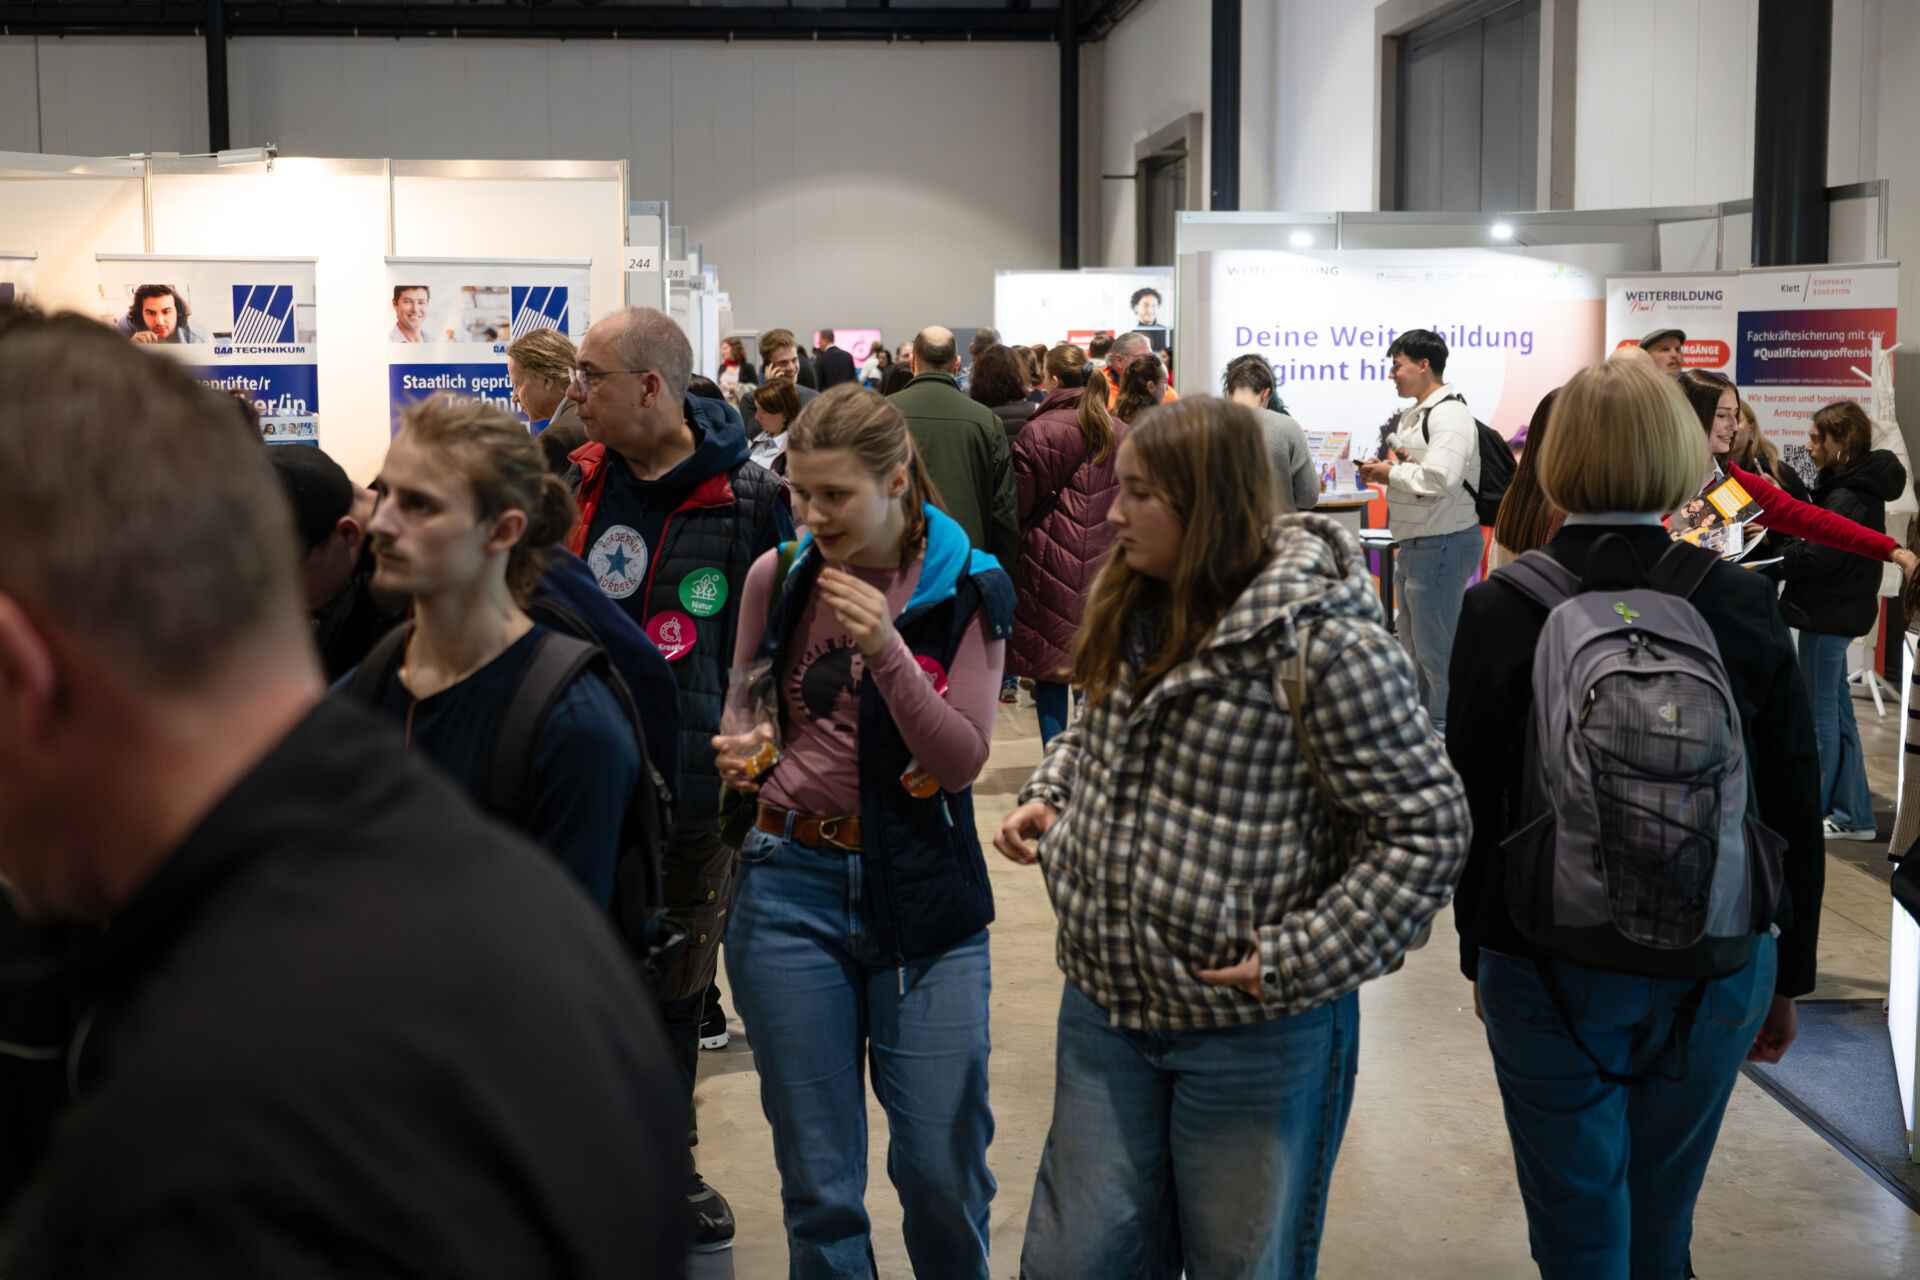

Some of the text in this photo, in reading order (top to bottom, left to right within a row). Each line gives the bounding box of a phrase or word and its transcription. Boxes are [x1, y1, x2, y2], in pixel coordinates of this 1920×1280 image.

[629, 259, 650, 269] 244
[667, 270, 684, 279] 243
[1814, 278, 1852, 286] CORPORATE
[1781, 284, 1800, 293] Klett
[1813, 288, 1850, 296] EDUCATION
[1625, 290, 1723, 302] WEITERBILDUNG
[1236, 325, 1533, 355] Deine Weitbildung
[1747, 330, 1845, 342] Fachkräftesicherung
[1848, 329, 1865, 340] mit
[1753, 347, 1873, 360] #Qualifizierungsoffensiv
[1273, 358, 1391, 387] ginnt hi
[403, 374, 512, 391] Staatlich geprü
[1748, 394, 1762, 403] Wir
[1765, 394, 1796, 403] beraten
[1799, 394, 1815, 403] und
[253, 393, 307, 416] er/in
[1773, 409, 1816, 420] Antragsp
[1782, 428, 1805, 436] Termin
[598, 575, 635, 592] NORDSEE
[691, 601, 713, 610] Natur
[658, 643, 685, 651] Kreativ
